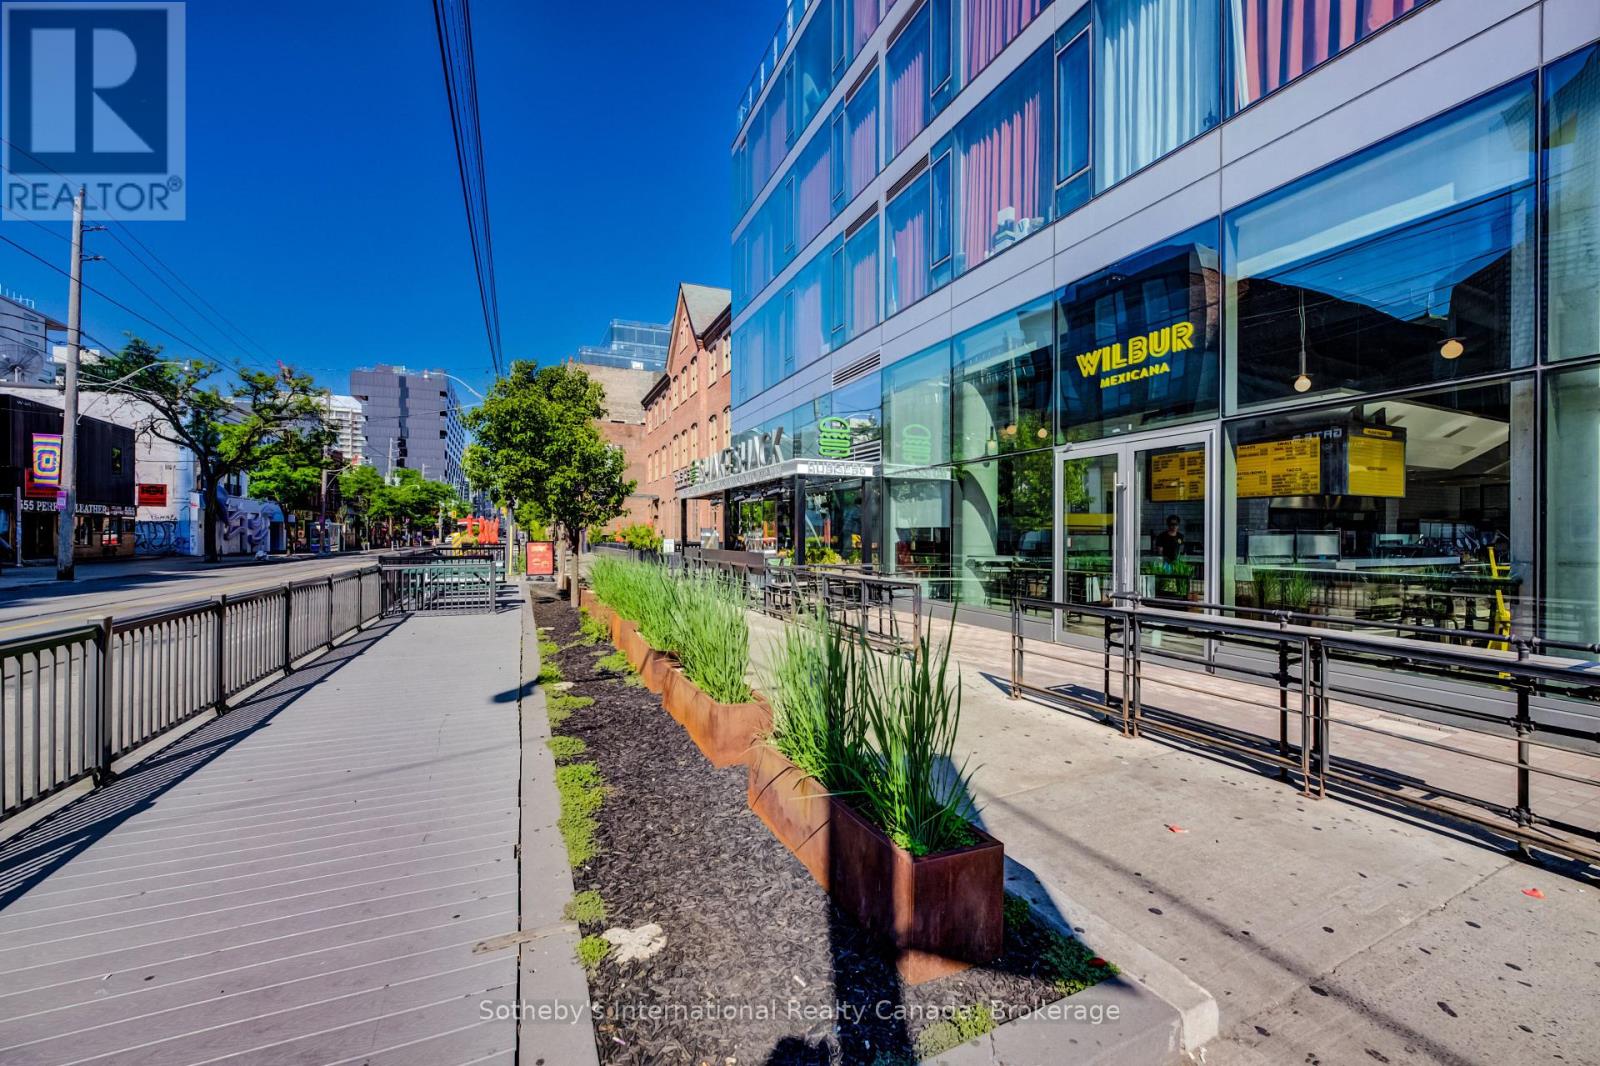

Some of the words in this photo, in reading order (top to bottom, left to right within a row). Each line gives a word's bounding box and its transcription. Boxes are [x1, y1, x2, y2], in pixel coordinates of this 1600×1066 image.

[1076, 321, 1195, 378] WILBUR
[1100, 362, 1170, 389] MEXICANA
[733, 426, 784, 474] SHACK
[75, 503, 107, 513] LEATHER
